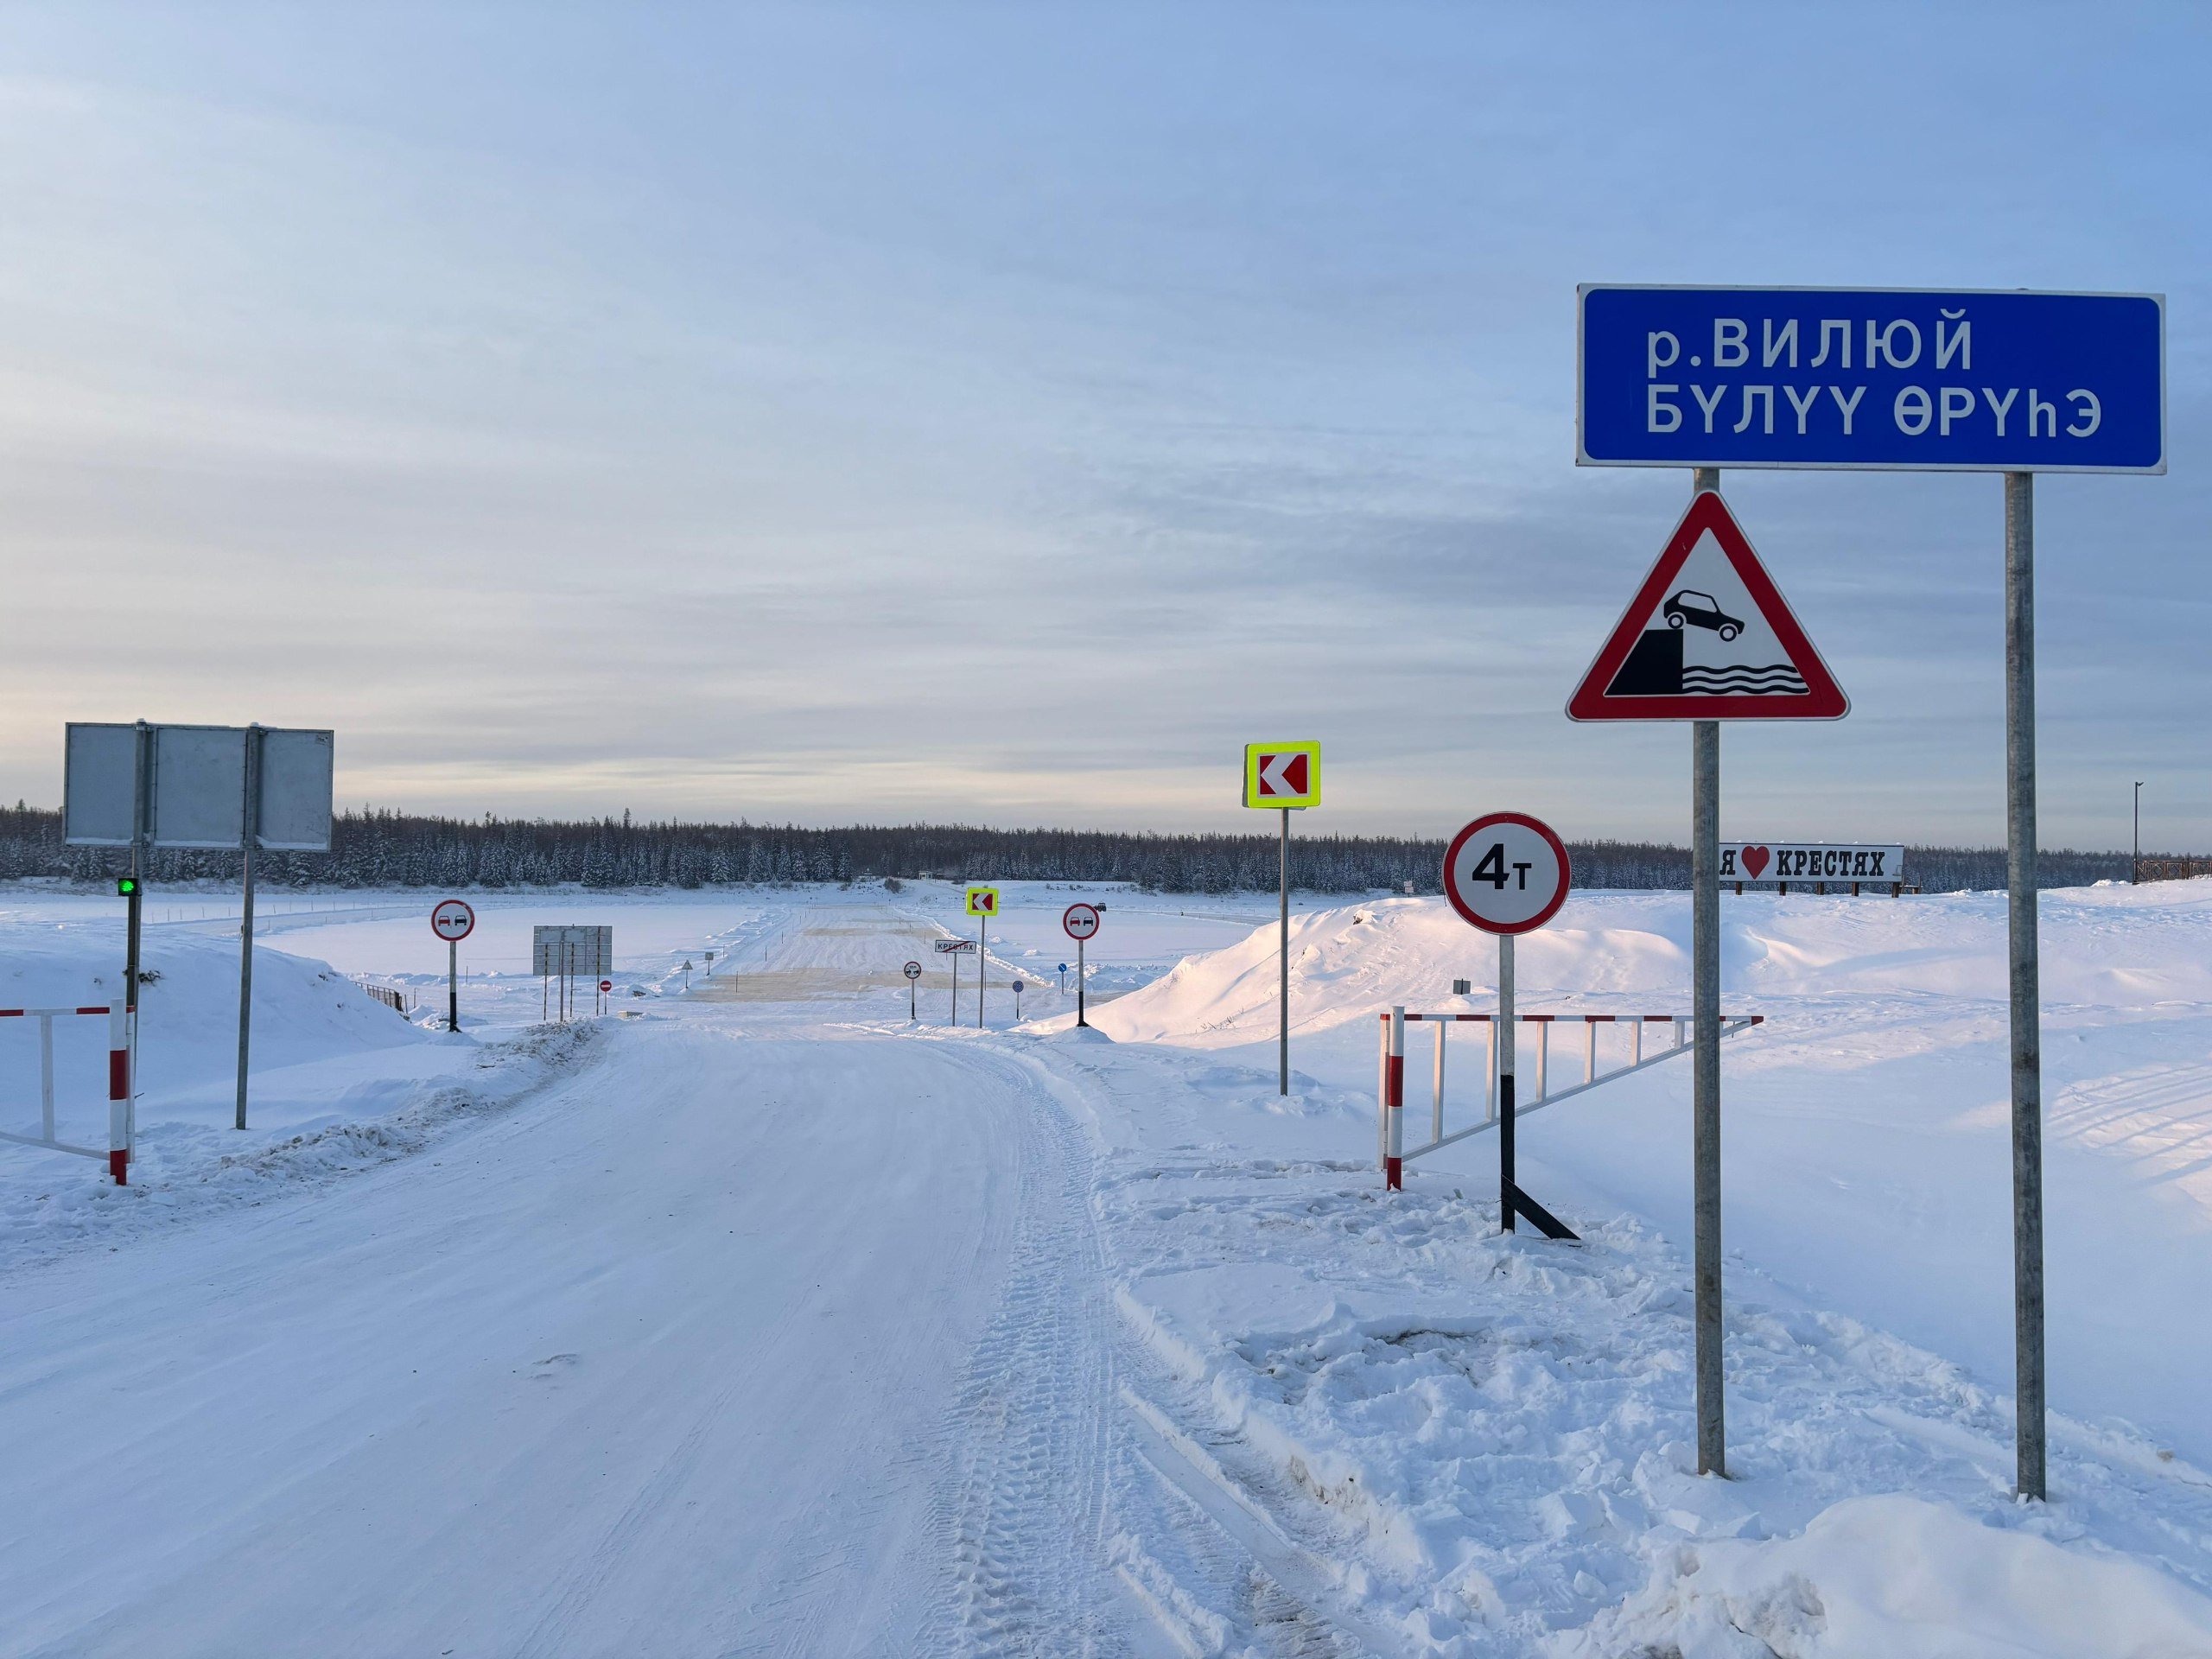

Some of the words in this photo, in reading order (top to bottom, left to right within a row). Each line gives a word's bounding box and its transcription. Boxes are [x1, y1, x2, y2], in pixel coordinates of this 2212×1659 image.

[1648, 308, 1972, 378] р.ВИЛЮЙ
[1719, 849, 1737, 875] Я
[1777, 850, 1885, 876] КРЕСТЯХ
